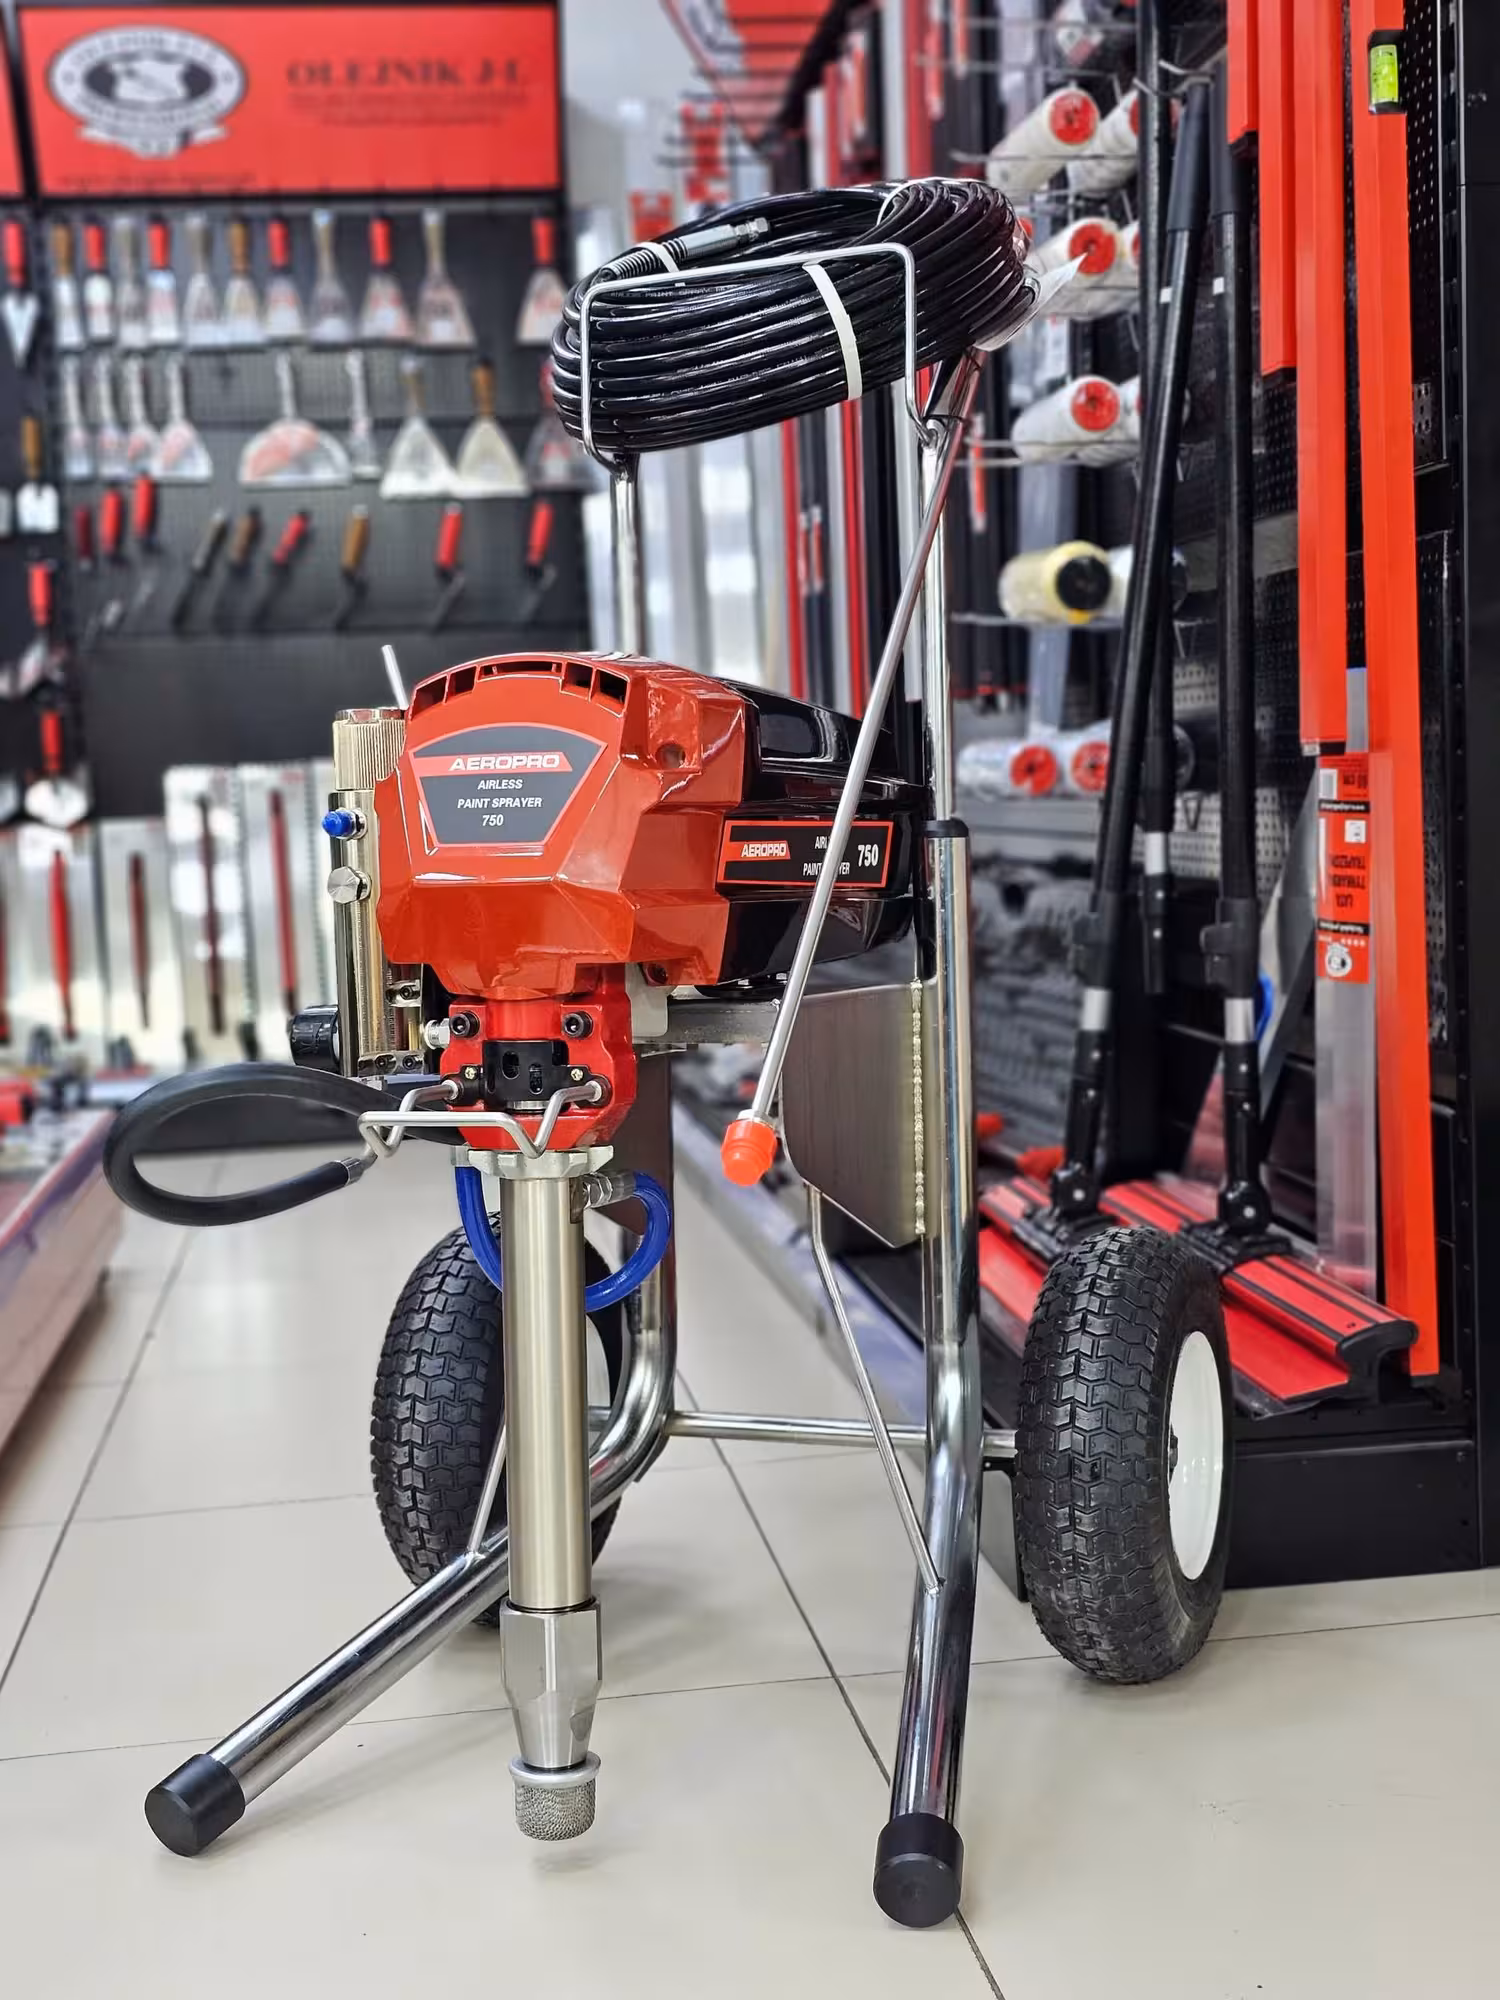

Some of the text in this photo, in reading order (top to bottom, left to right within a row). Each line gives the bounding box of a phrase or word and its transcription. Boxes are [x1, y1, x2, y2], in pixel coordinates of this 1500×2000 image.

[449, 754, 560, 771] AEROPRO
[477, 779, 523, 790] AIRLESS
[457, 797, 543, 809] PAINT SPRAYER
[482, 814, 504, 827] 750
[741, 843, 787, 858] AEROPRO
[857, 844, 879, 867] 750
